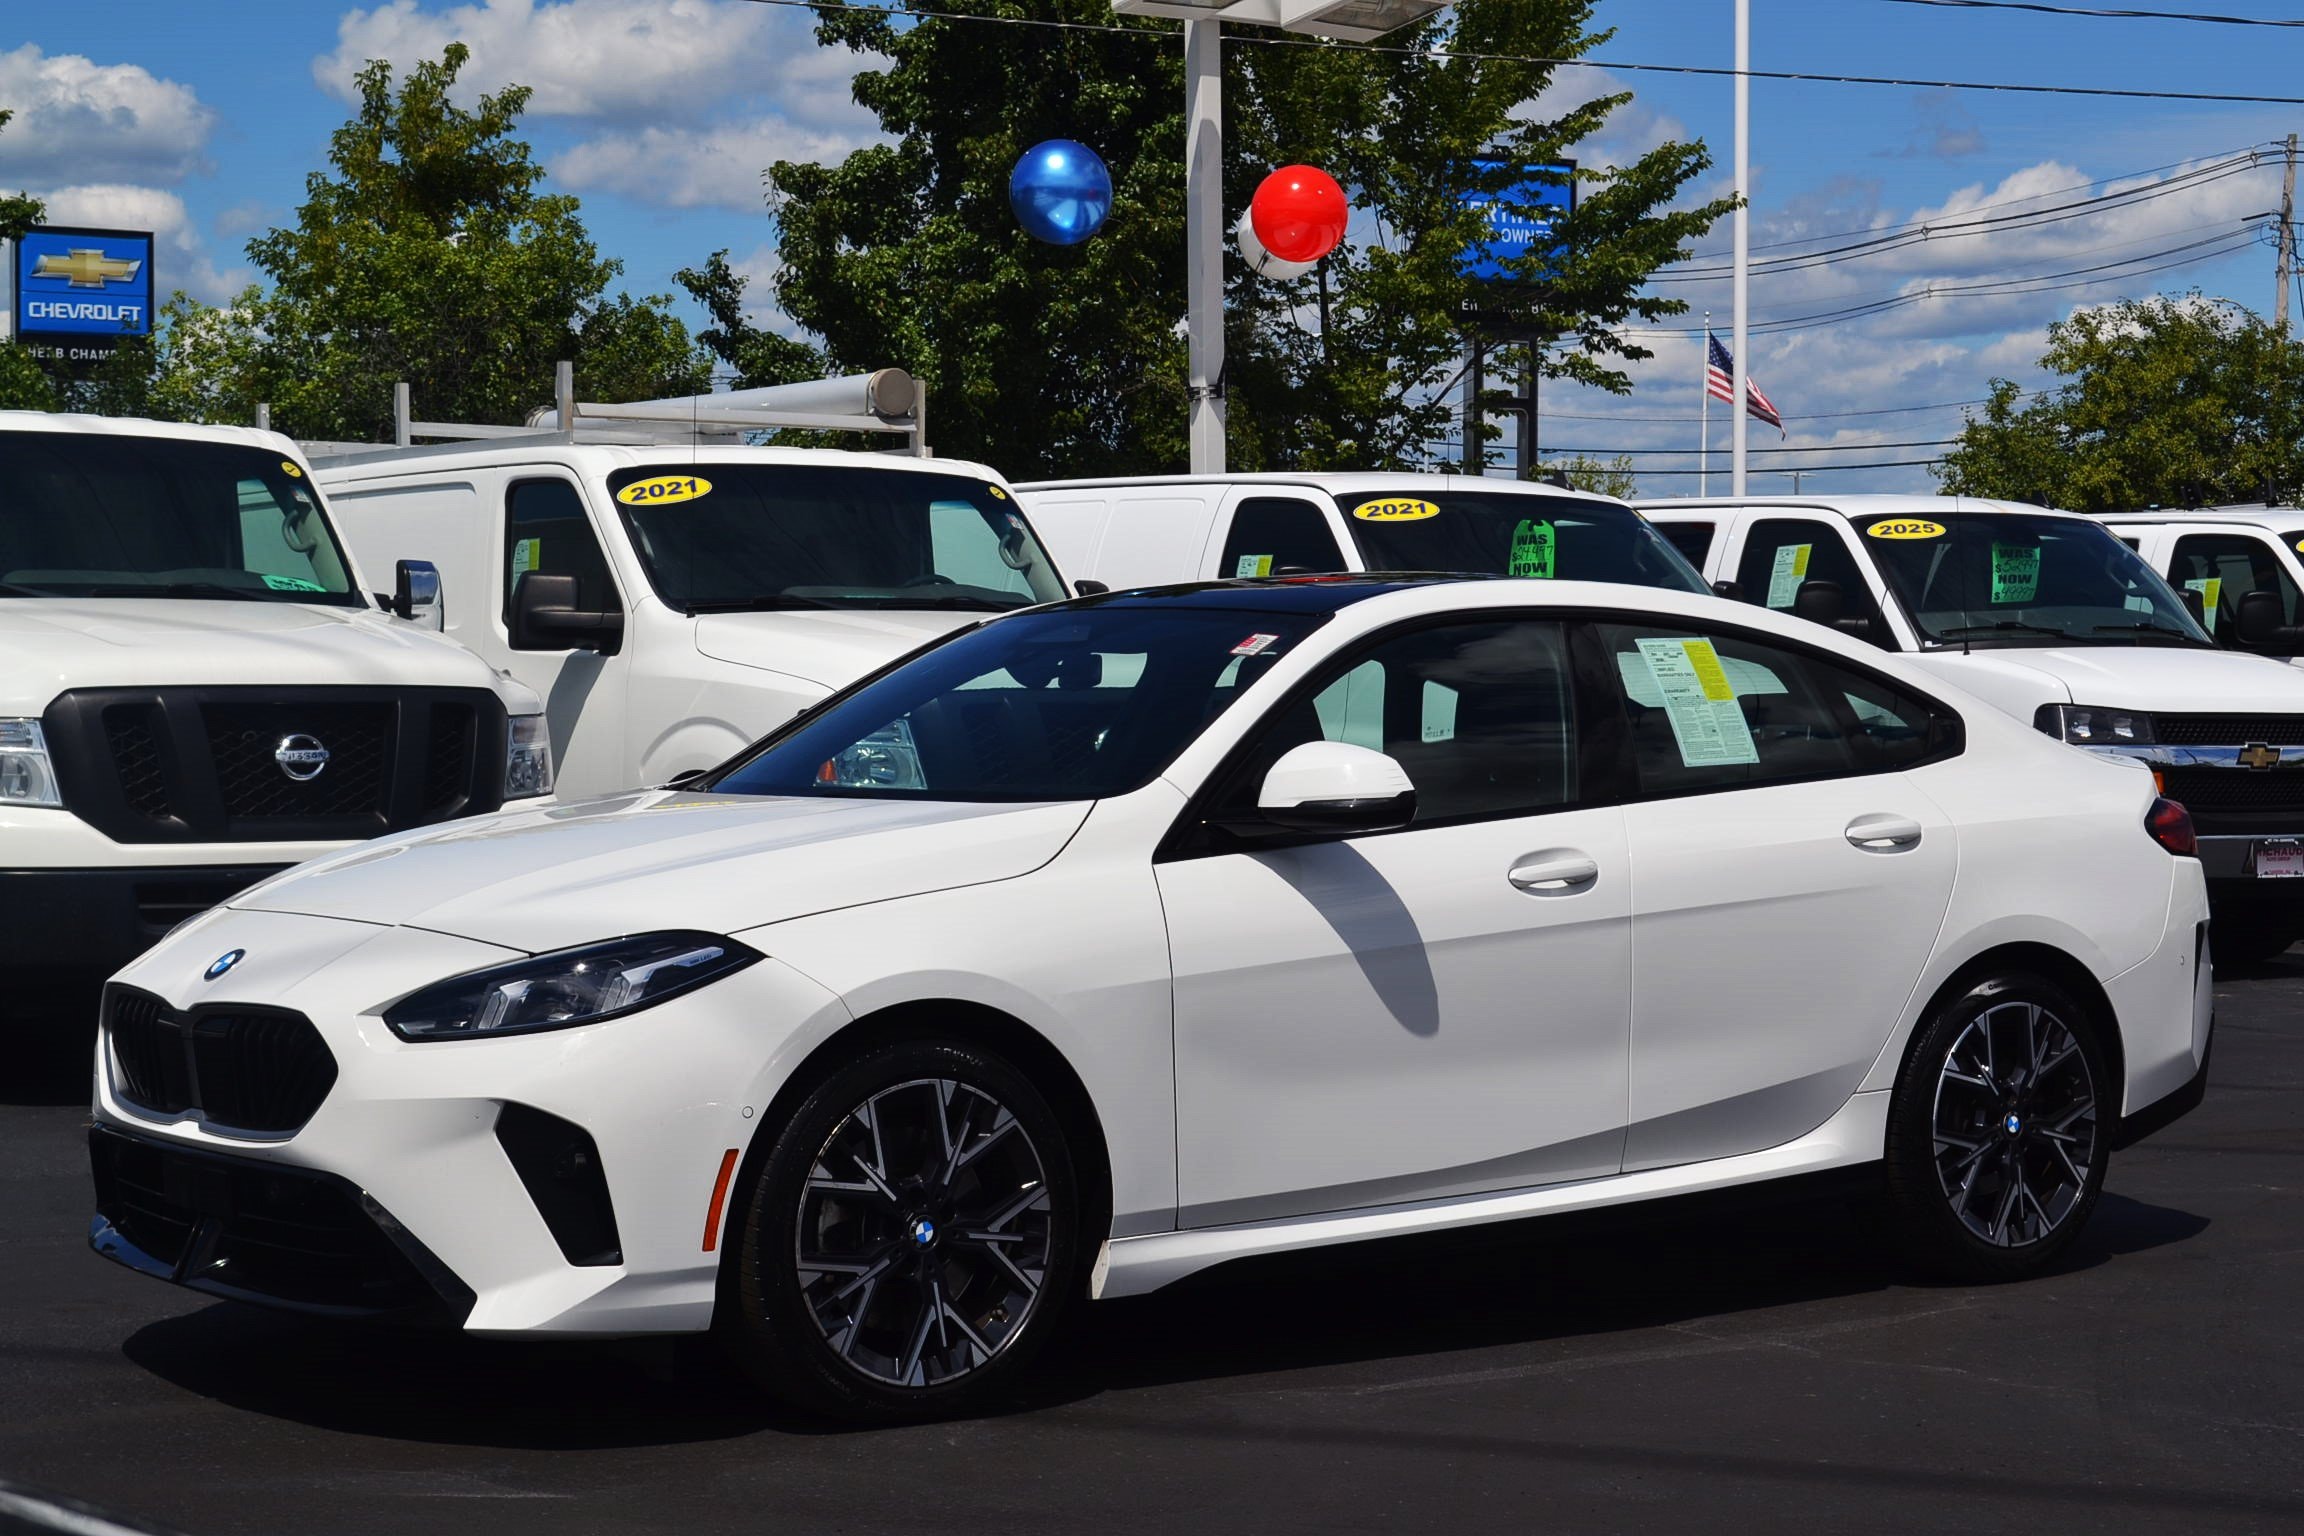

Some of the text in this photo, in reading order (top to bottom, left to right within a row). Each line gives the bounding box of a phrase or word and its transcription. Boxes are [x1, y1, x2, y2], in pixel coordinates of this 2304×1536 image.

[28, 301, 142, 321] CHEVROLET
[28, 347, 65, 359] HEB
[630, 479, 698, 502] 2021
[1366, 502, 1427, 517] 2021
[1879, 523, 1936, 536] 2025
[1517, 533, 1548, 546] WAS
[1998, 549, 2034, 559] WAS
[1513, 561, 1548, 576] NOW
[1997, 574, 2033, 585] NOW
